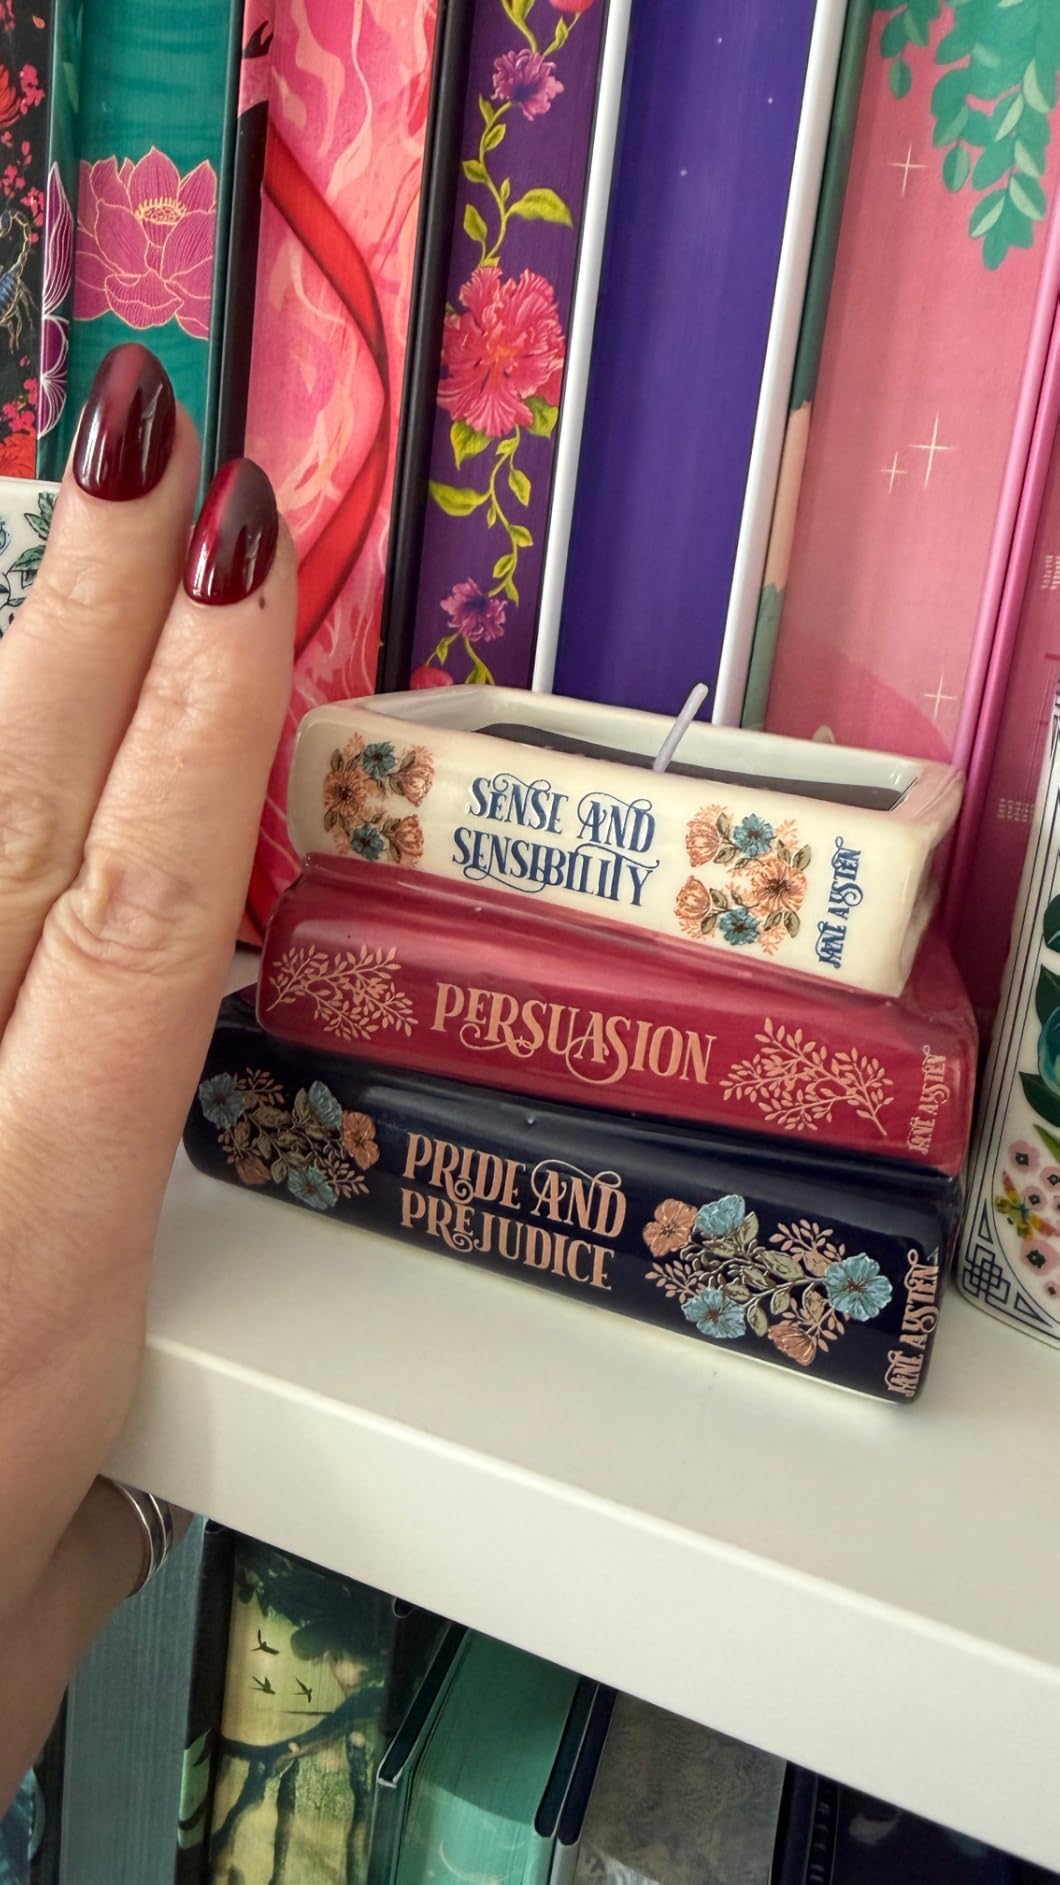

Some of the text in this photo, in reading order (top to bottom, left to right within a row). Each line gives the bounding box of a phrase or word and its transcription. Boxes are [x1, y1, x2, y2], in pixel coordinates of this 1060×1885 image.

[468, 773, 656, 853] SENSE AND
[452, 827, 660, 906] SENSIBILITY
[815, 921, 847, 969] JANE
[429, 982, 718, 1085] PERSUASION
[906, 1116, 936, 1155] JANE
[402, 1131, 627, 1238] PRIDE AND
[400, 1187, 615, 1290] PREJUDICE
[884, 1350, 924, 1398] JANE
